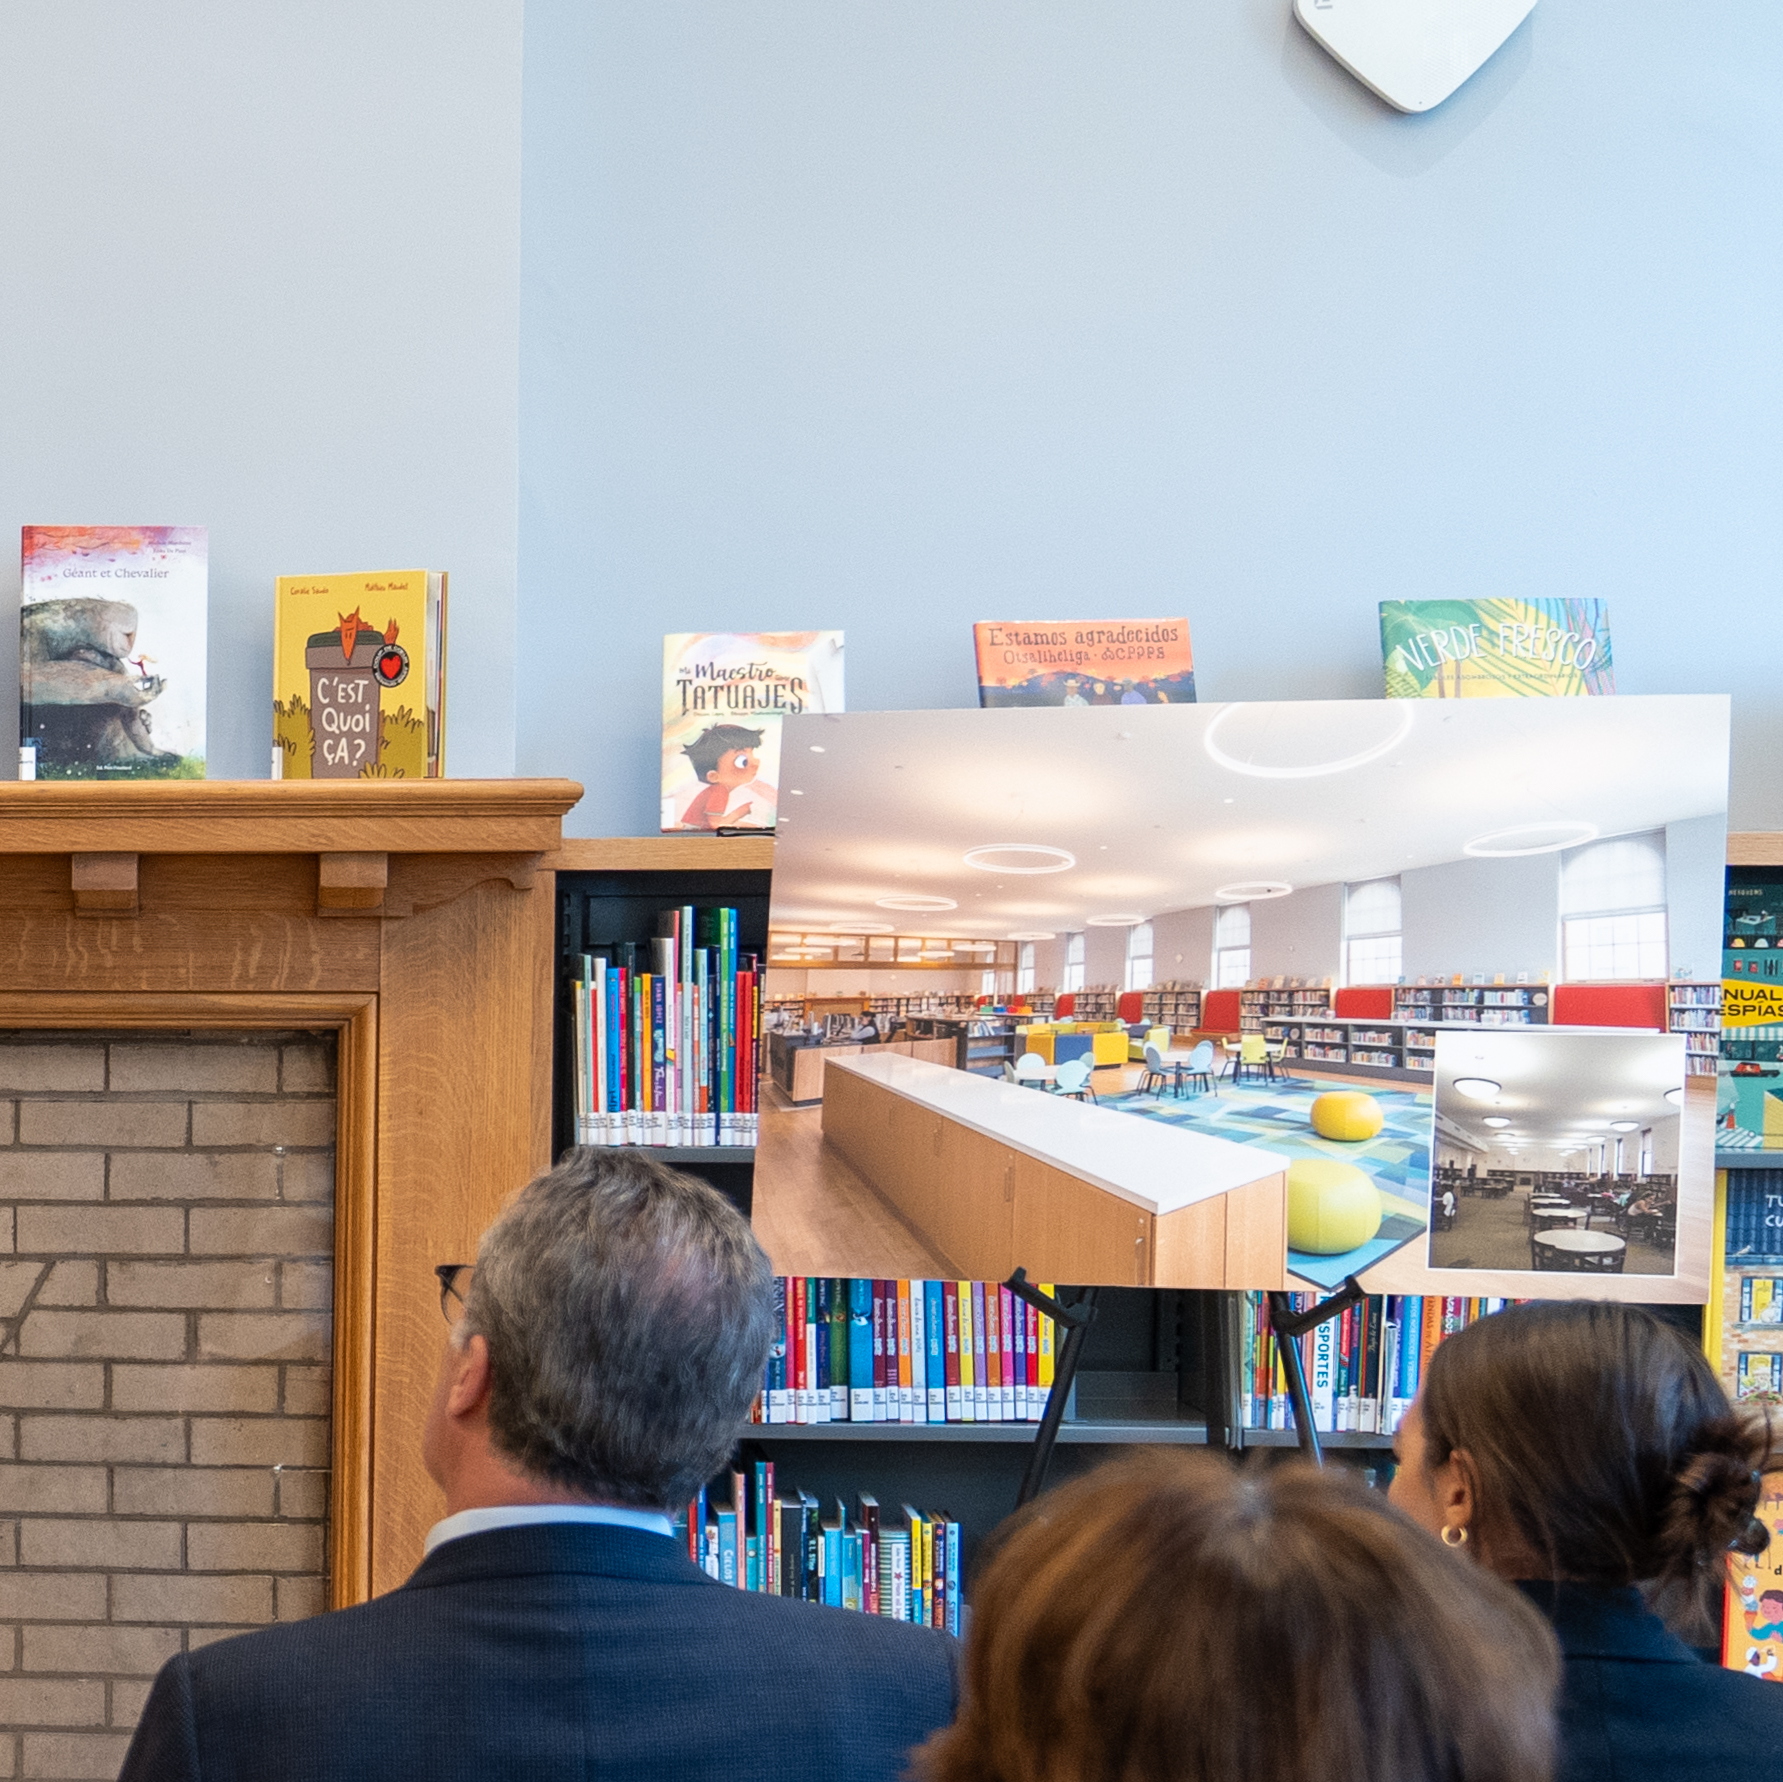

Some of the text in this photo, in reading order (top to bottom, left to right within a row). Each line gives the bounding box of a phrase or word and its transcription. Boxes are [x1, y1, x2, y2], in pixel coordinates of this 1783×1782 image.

[63, 566, 169, 579] Géant et Chevalier
[988, 625, 1178, 647] Estamos agradecidos
[1395, 623, 1597, 671] VERDE FRESCO
[696, 661, 776, 681] Maestro
[317, 677, 369, 704] C'EST
[676, 677, 803, 716] TATUAJES
[321, 704, 370, 734] QUOI
